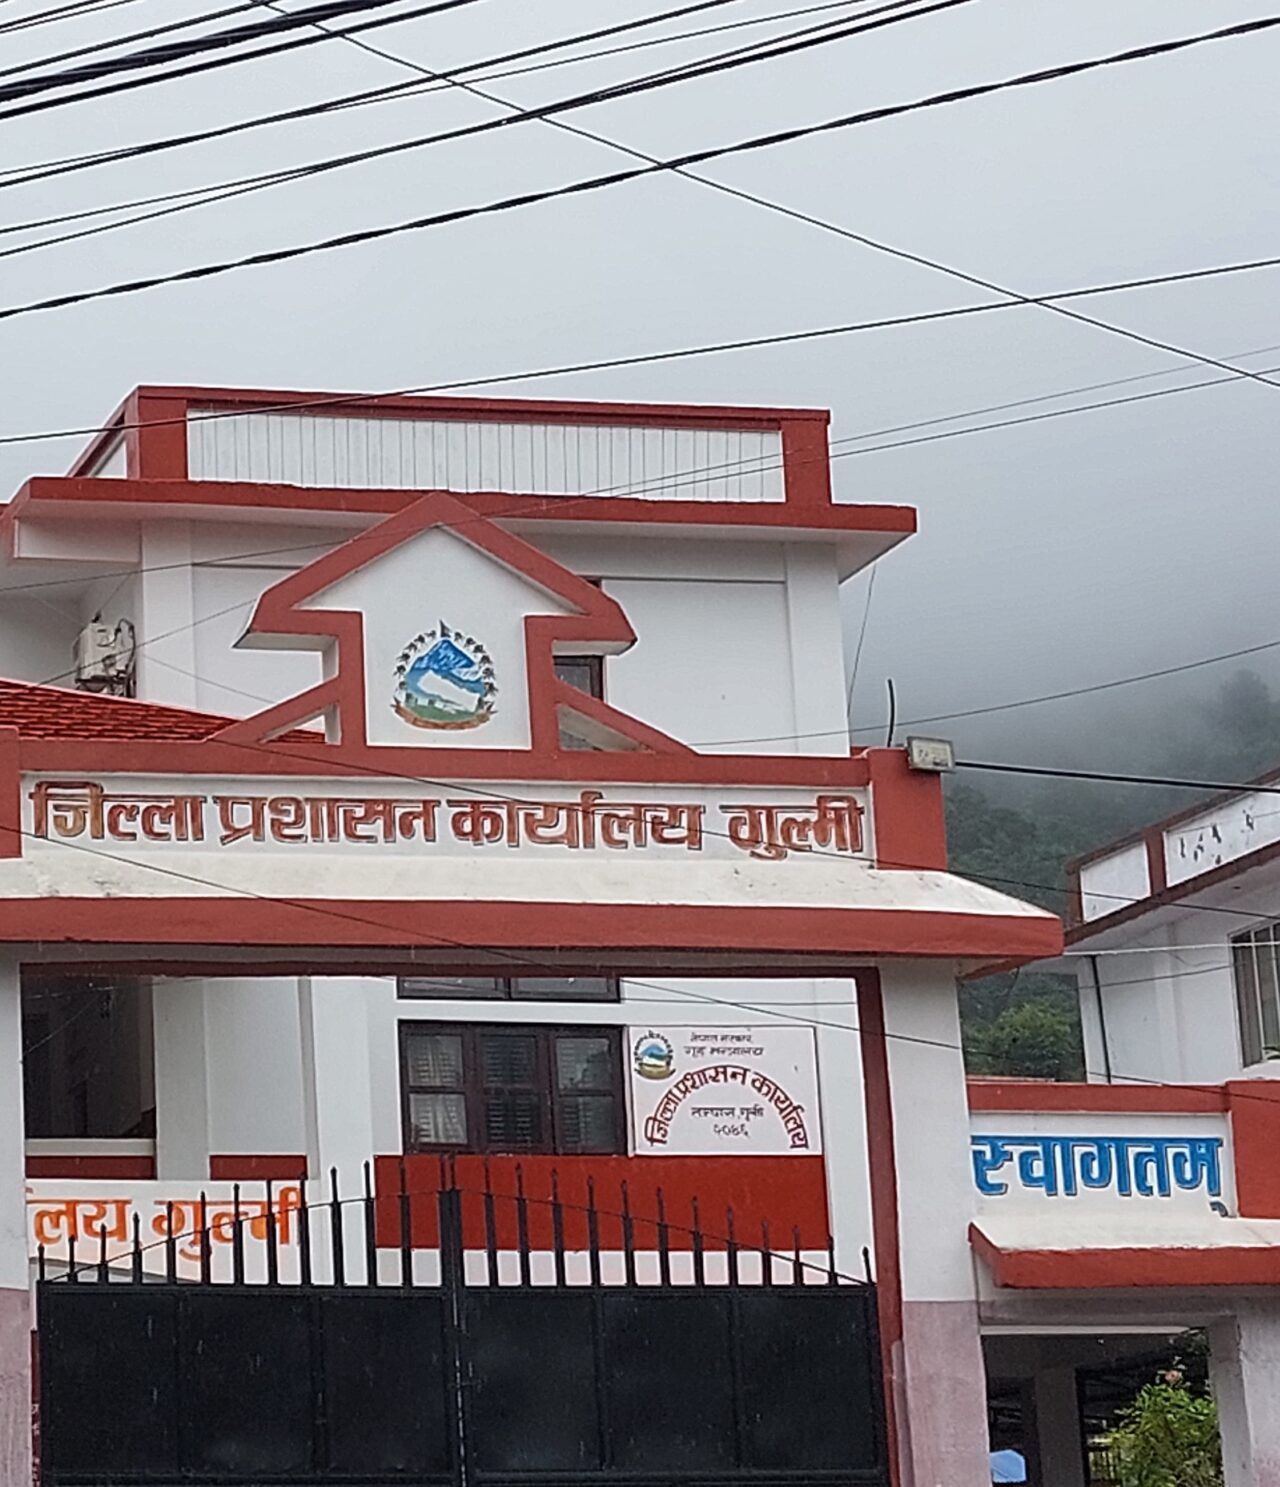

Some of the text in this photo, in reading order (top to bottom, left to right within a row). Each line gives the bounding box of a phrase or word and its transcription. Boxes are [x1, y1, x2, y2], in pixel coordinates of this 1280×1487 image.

[28, 781, 865, 860] जिल्ला प्रशासन कार्यालय गुल्मी
[751, 1071, 809, 1149] कार्यालय
[970, 1135, 1228, 1217] स्वागतम्
